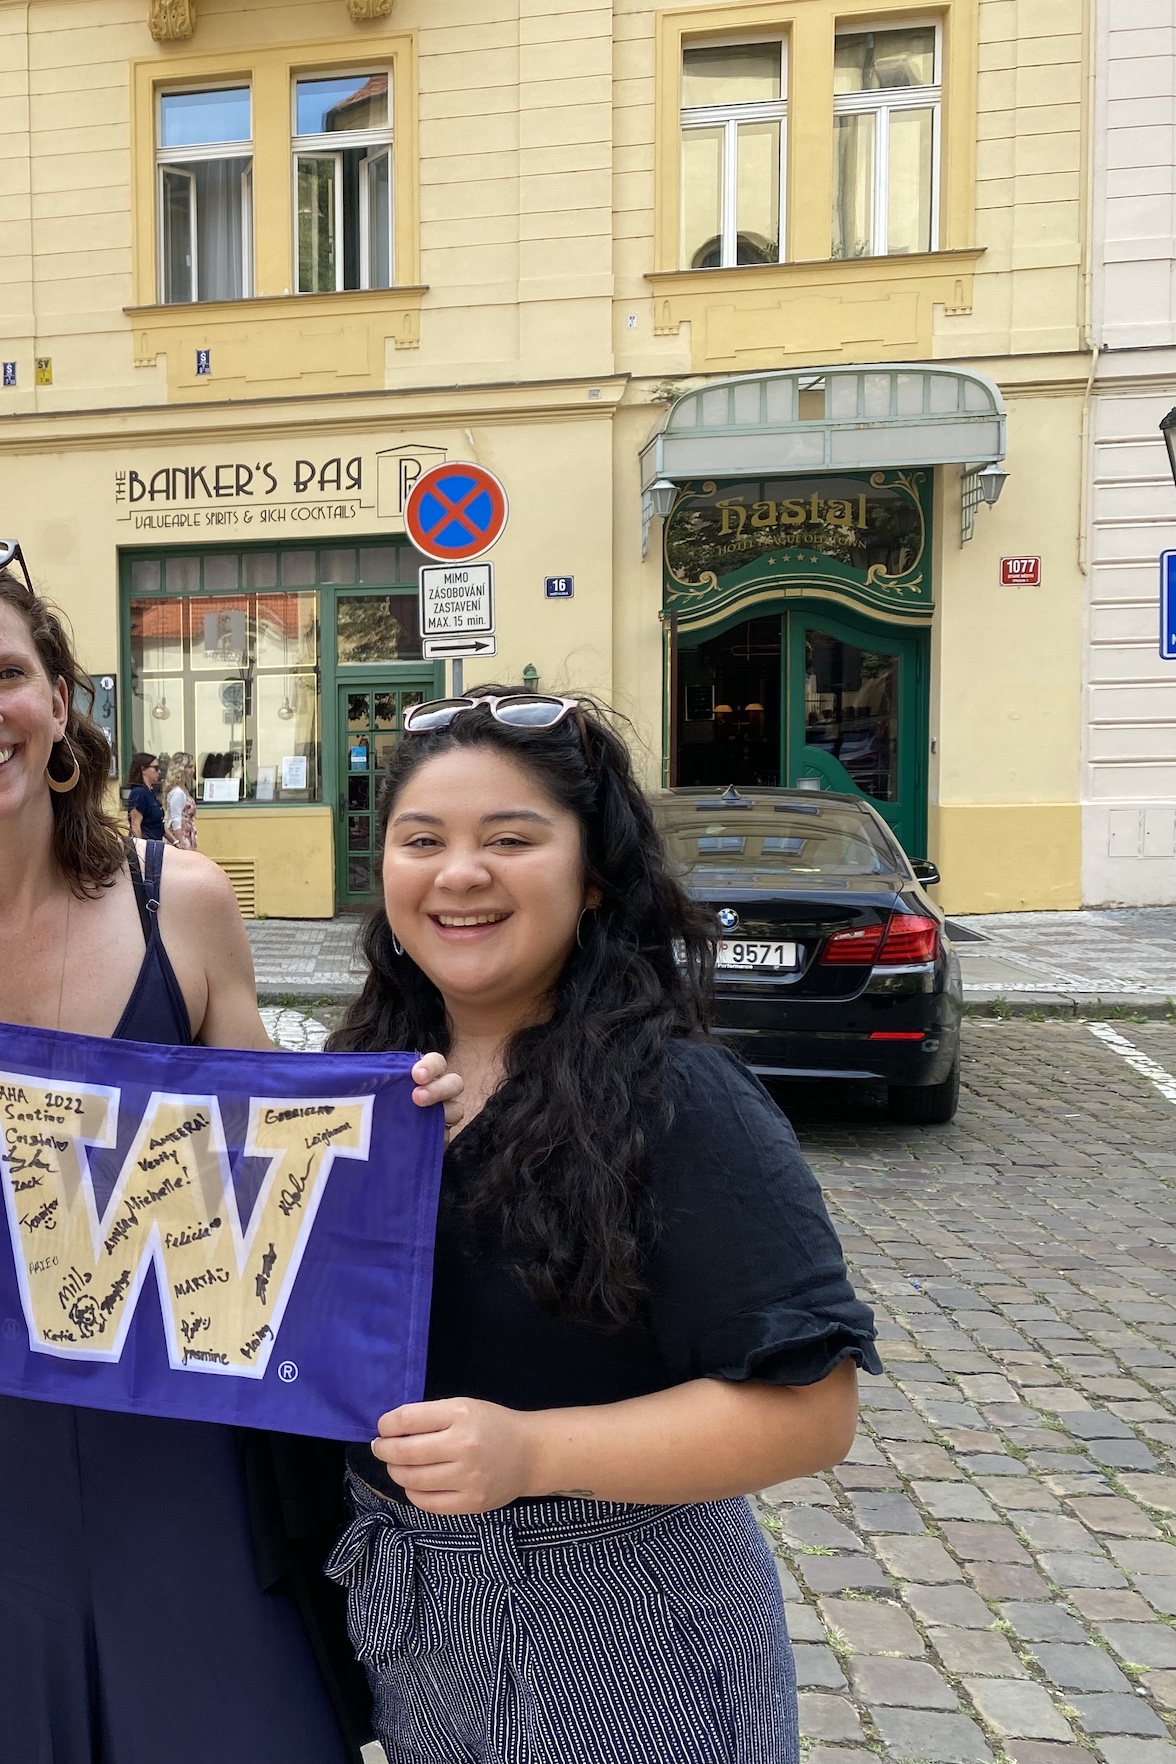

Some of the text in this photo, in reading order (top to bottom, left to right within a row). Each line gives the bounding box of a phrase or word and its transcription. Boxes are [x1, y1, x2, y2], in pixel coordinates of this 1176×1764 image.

[115, 470, 126, 503] THE
[128, 461, 278, 502] BANKER'S
[293, 456, 362, 493] BAR
[135, 504, 356, 529] VALUEABLE SPIRITS & RICH COCKTAILS
[1007, 560, 1035, 573] 1077
[444, 571, 469, 584] MIMO
[552, 579, 566, 591] 16
[429, 583, 486, 600] ZÁSOBOVÁNÍ
[433, 597, 481, 614] ZASTAVENÍ
[428, 614, 486, 629] MAX. 15 min.
[733, 943, 784, 964] 9571
[45, 1092, 85, 1114] 2022
[137, 1149, 180, 1172] Verity
[174, 1269, 217, 1298] MARTA
[42, 1329, 77, 1342] Katie
